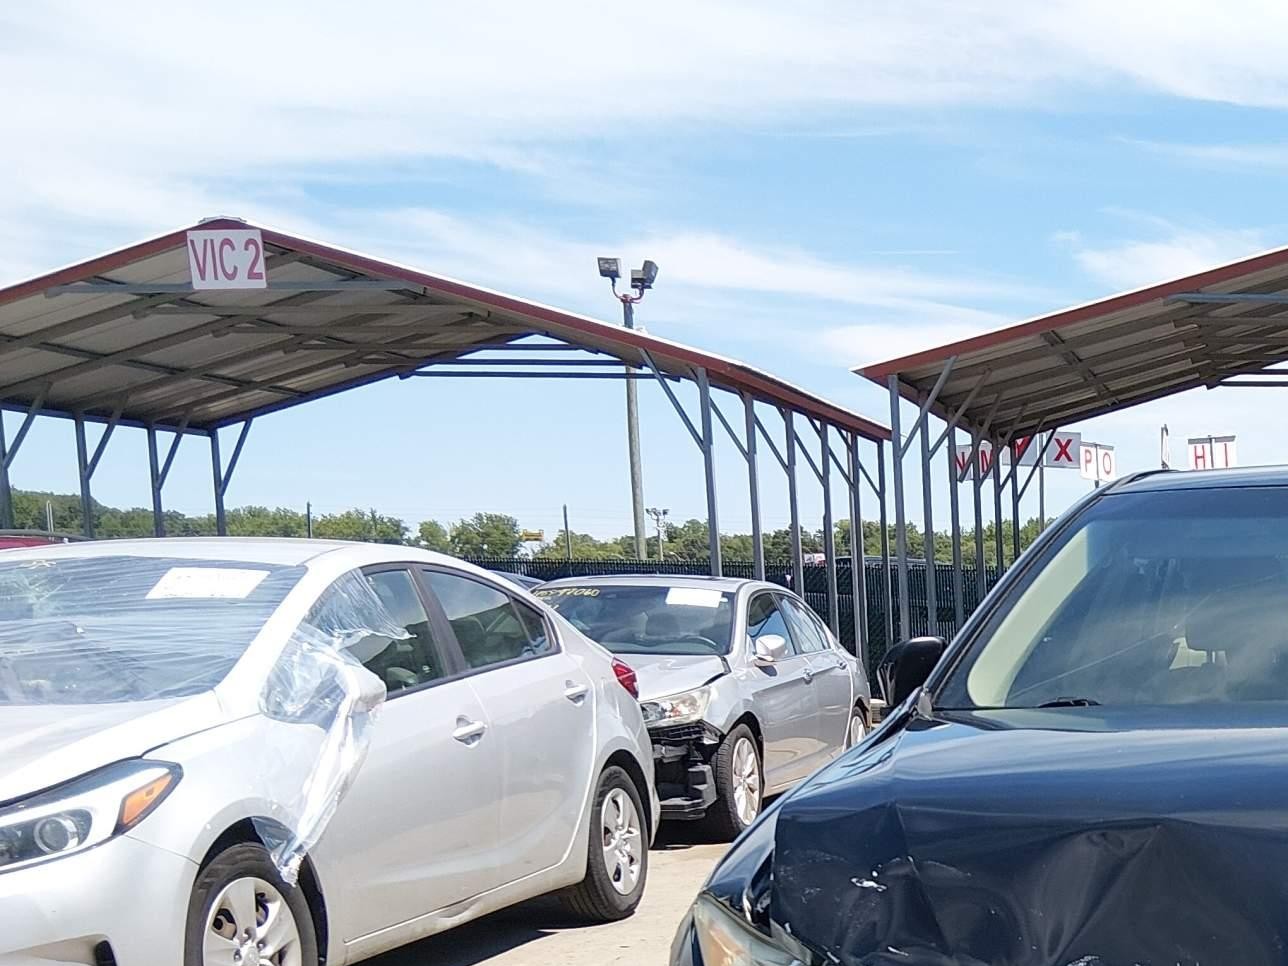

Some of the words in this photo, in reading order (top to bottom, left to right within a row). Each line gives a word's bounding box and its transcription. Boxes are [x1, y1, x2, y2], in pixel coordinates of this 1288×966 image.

[189, 238, 238, 281] VIC
[244, 238, 264, 280] 2
[1054, 438, 1073, 462] X
[1085, 451, 1093, 472] P
[1194, 445, 1206, 469] H
